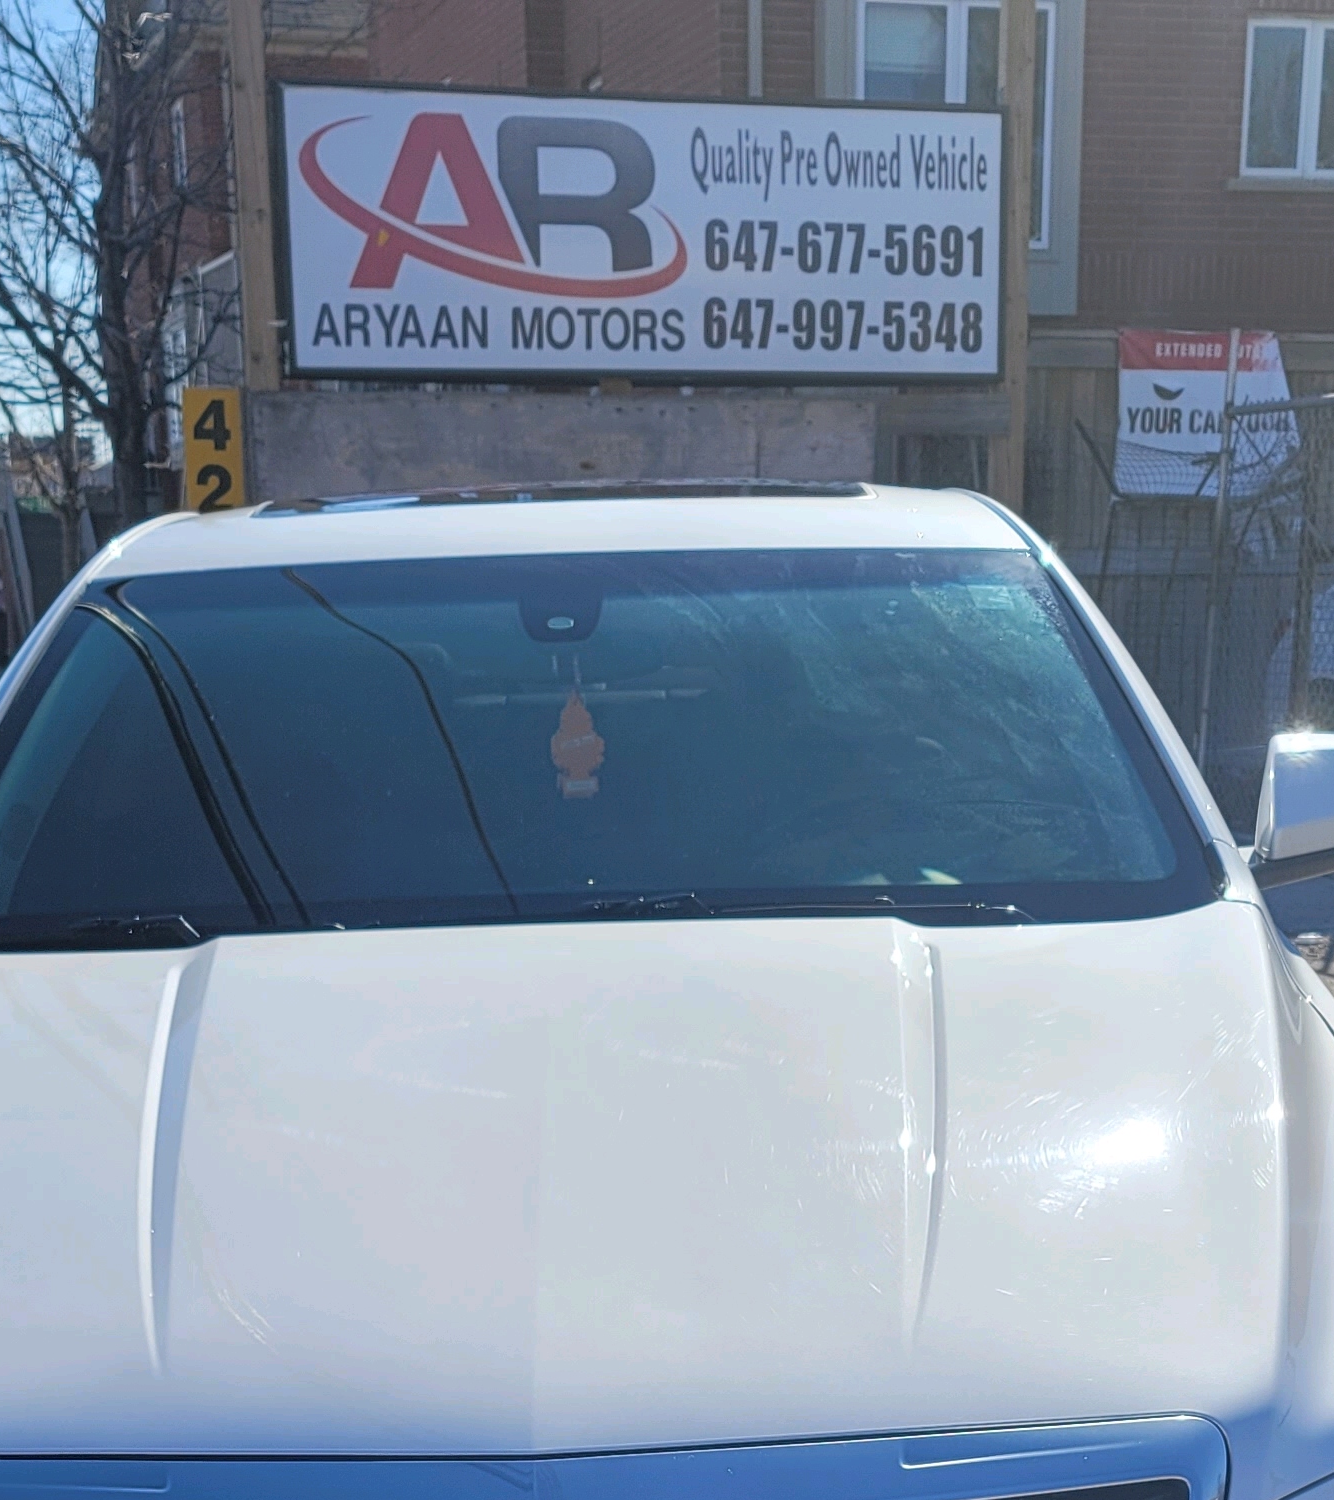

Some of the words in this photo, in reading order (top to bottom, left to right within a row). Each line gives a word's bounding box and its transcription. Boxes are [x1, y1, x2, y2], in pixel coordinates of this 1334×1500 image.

[689, 126, 774, 202] Quality
[780, 130, 818, 187] Pre
[824, 131, 900, 189] Owned
[909, 134, 987, 192] Vehicle
[704, 218, 984, 278] 647-677-5691
[312, 303, 489, 350] ARYAAN
[511, 306, 686, 352] MOTORS
[703, 297, 983, 354] 647-997-5348
[1154, 341, 1223, 359] EXTENDED
[1127, 406, 1182, 434] YOUR
